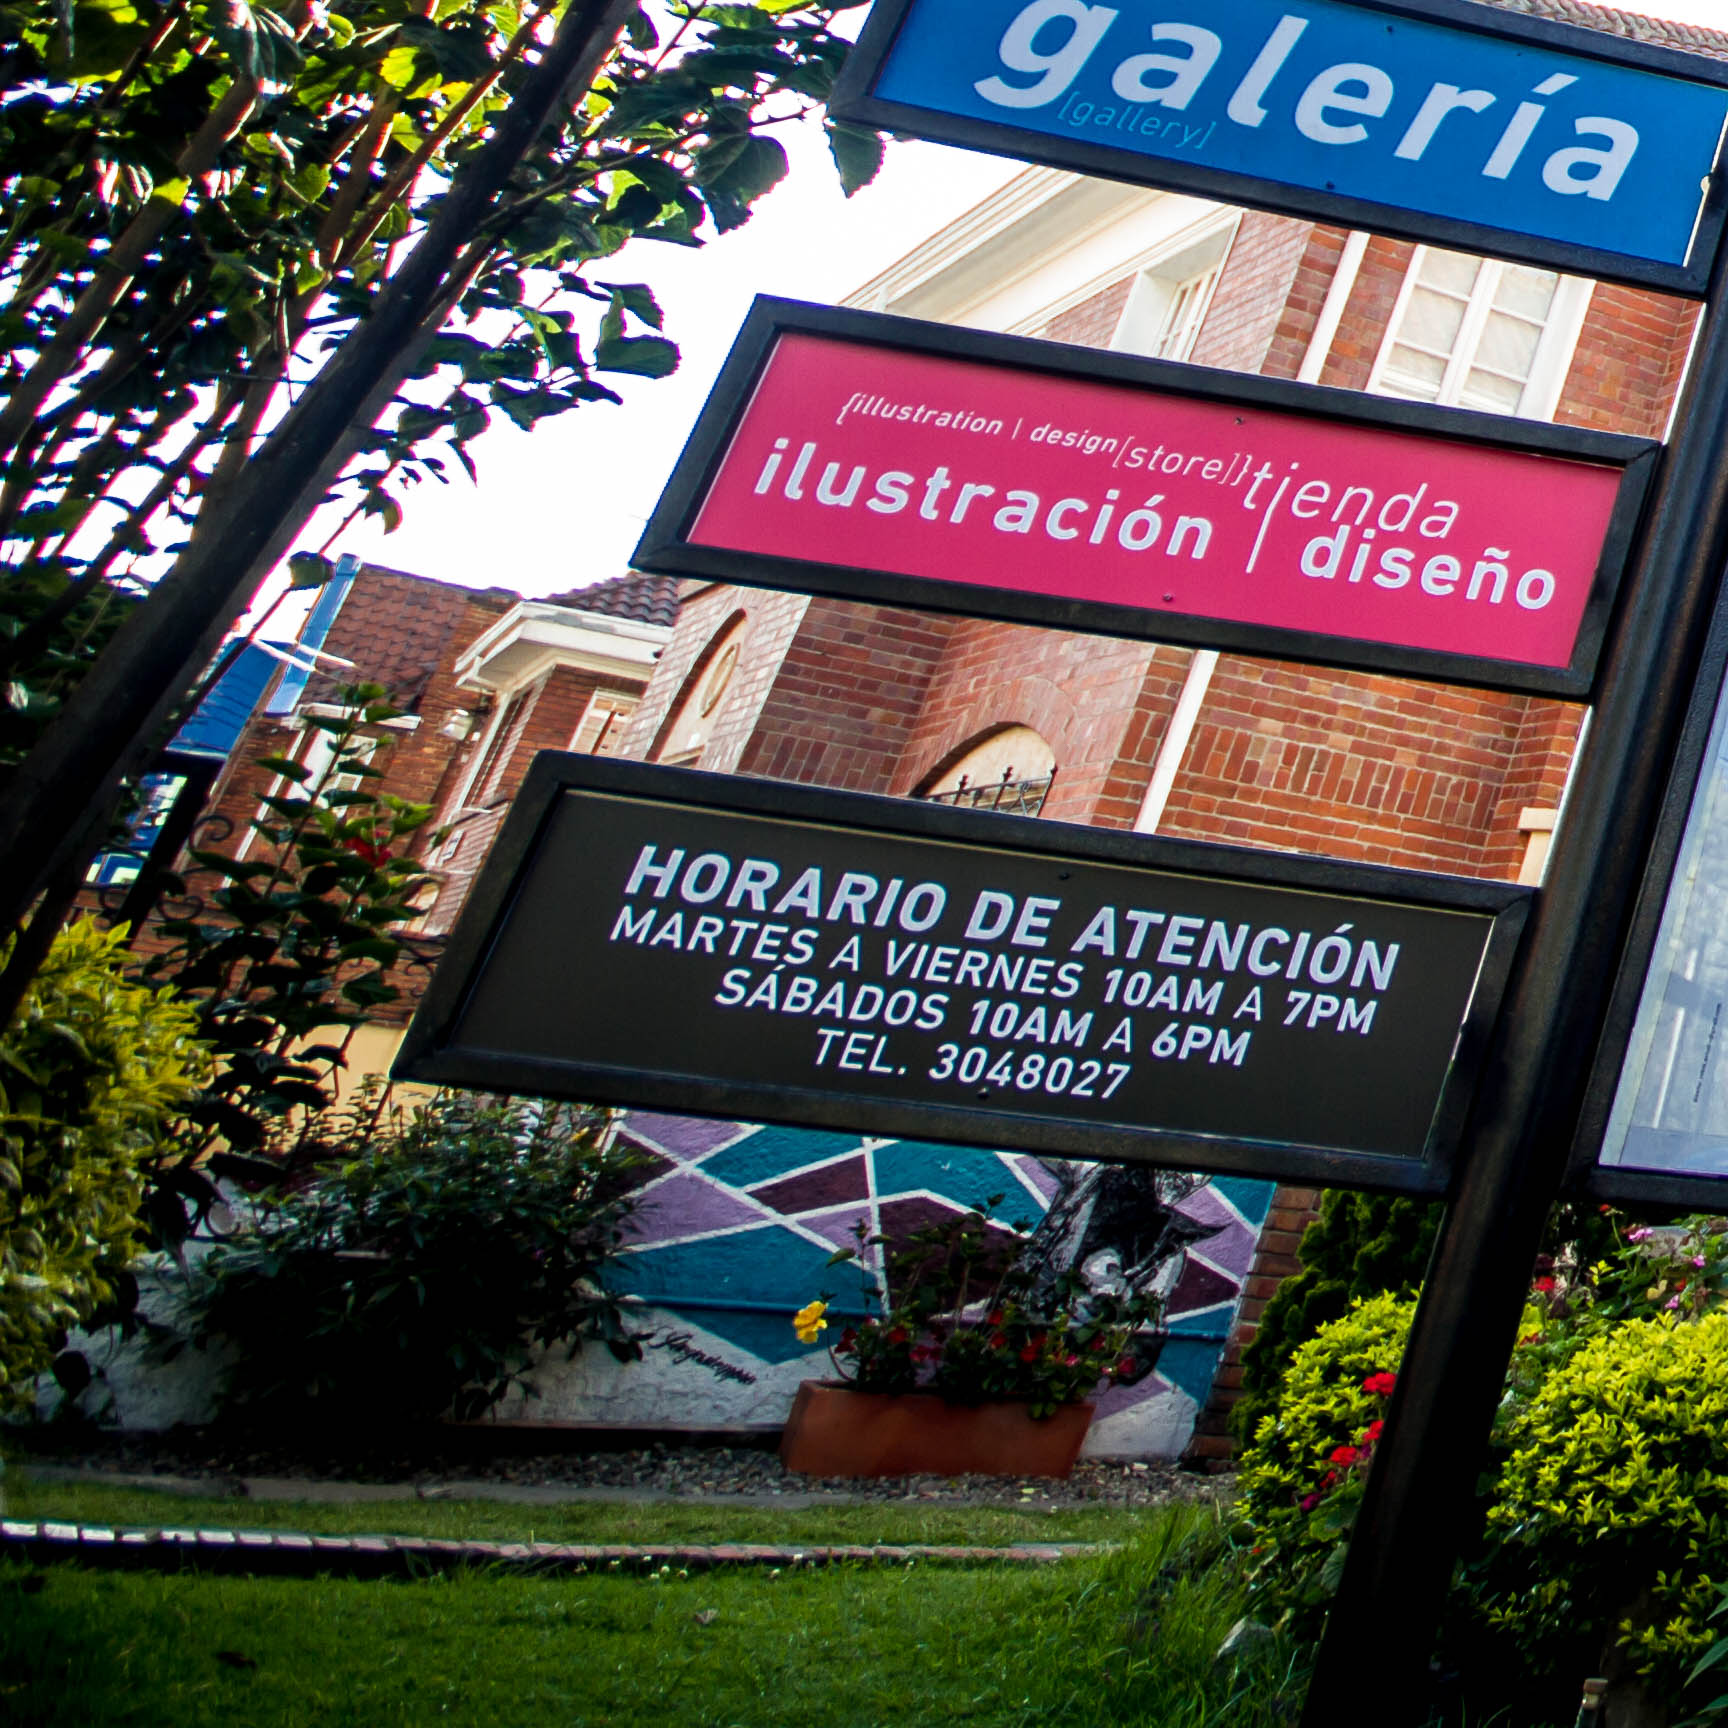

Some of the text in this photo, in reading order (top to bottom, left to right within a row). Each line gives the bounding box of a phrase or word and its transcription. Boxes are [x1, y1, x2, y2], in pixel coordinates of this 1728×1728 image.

[1058, 92, 1216, 151] [gallery]
[755, 439, 1557, 610] ilustración diseño
[1244, 461, 1460, 574] tienda
[609, 906, 1377, 1035] MARTES A VIERNES 10AM A 7PM
[625, 844, 1401, 991] HORARIO DE ATENCIÓN
[714, 968, 1251, 1067] SÁBADOS 10AM A 6PM
[812, 1030, 1129, 1100] TEL. 3048027
